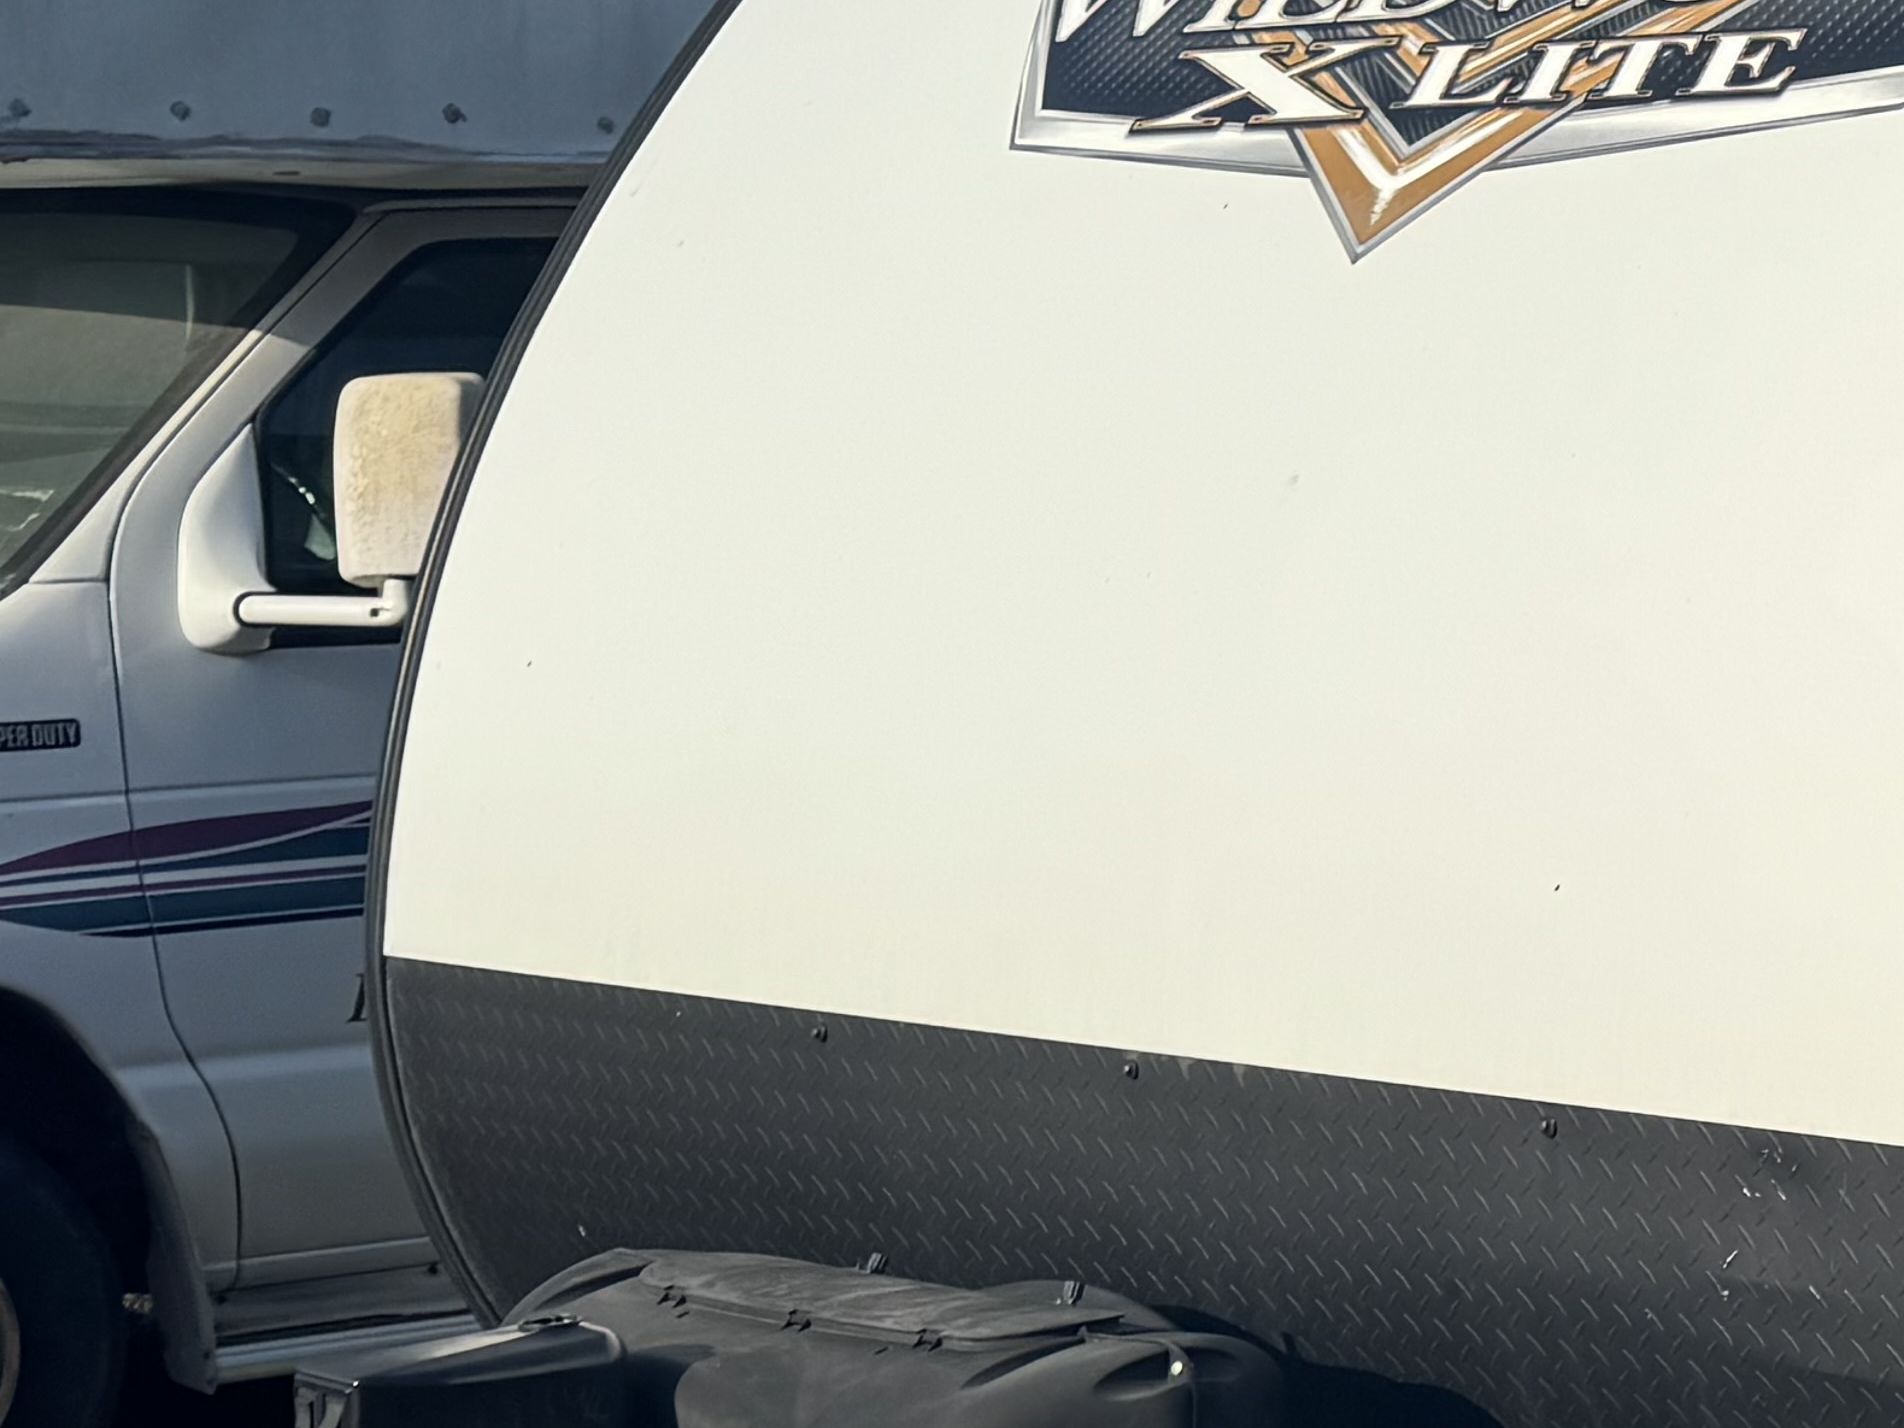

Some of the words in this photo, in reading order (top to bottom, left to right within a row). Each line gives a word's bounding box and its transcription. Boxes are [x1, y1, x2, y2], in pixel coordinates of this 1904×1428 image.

[1129, 35, 1399, 132] X
[1389, 28, 1808, 110] LITE
[31, 723, 77, 747] DUTY
